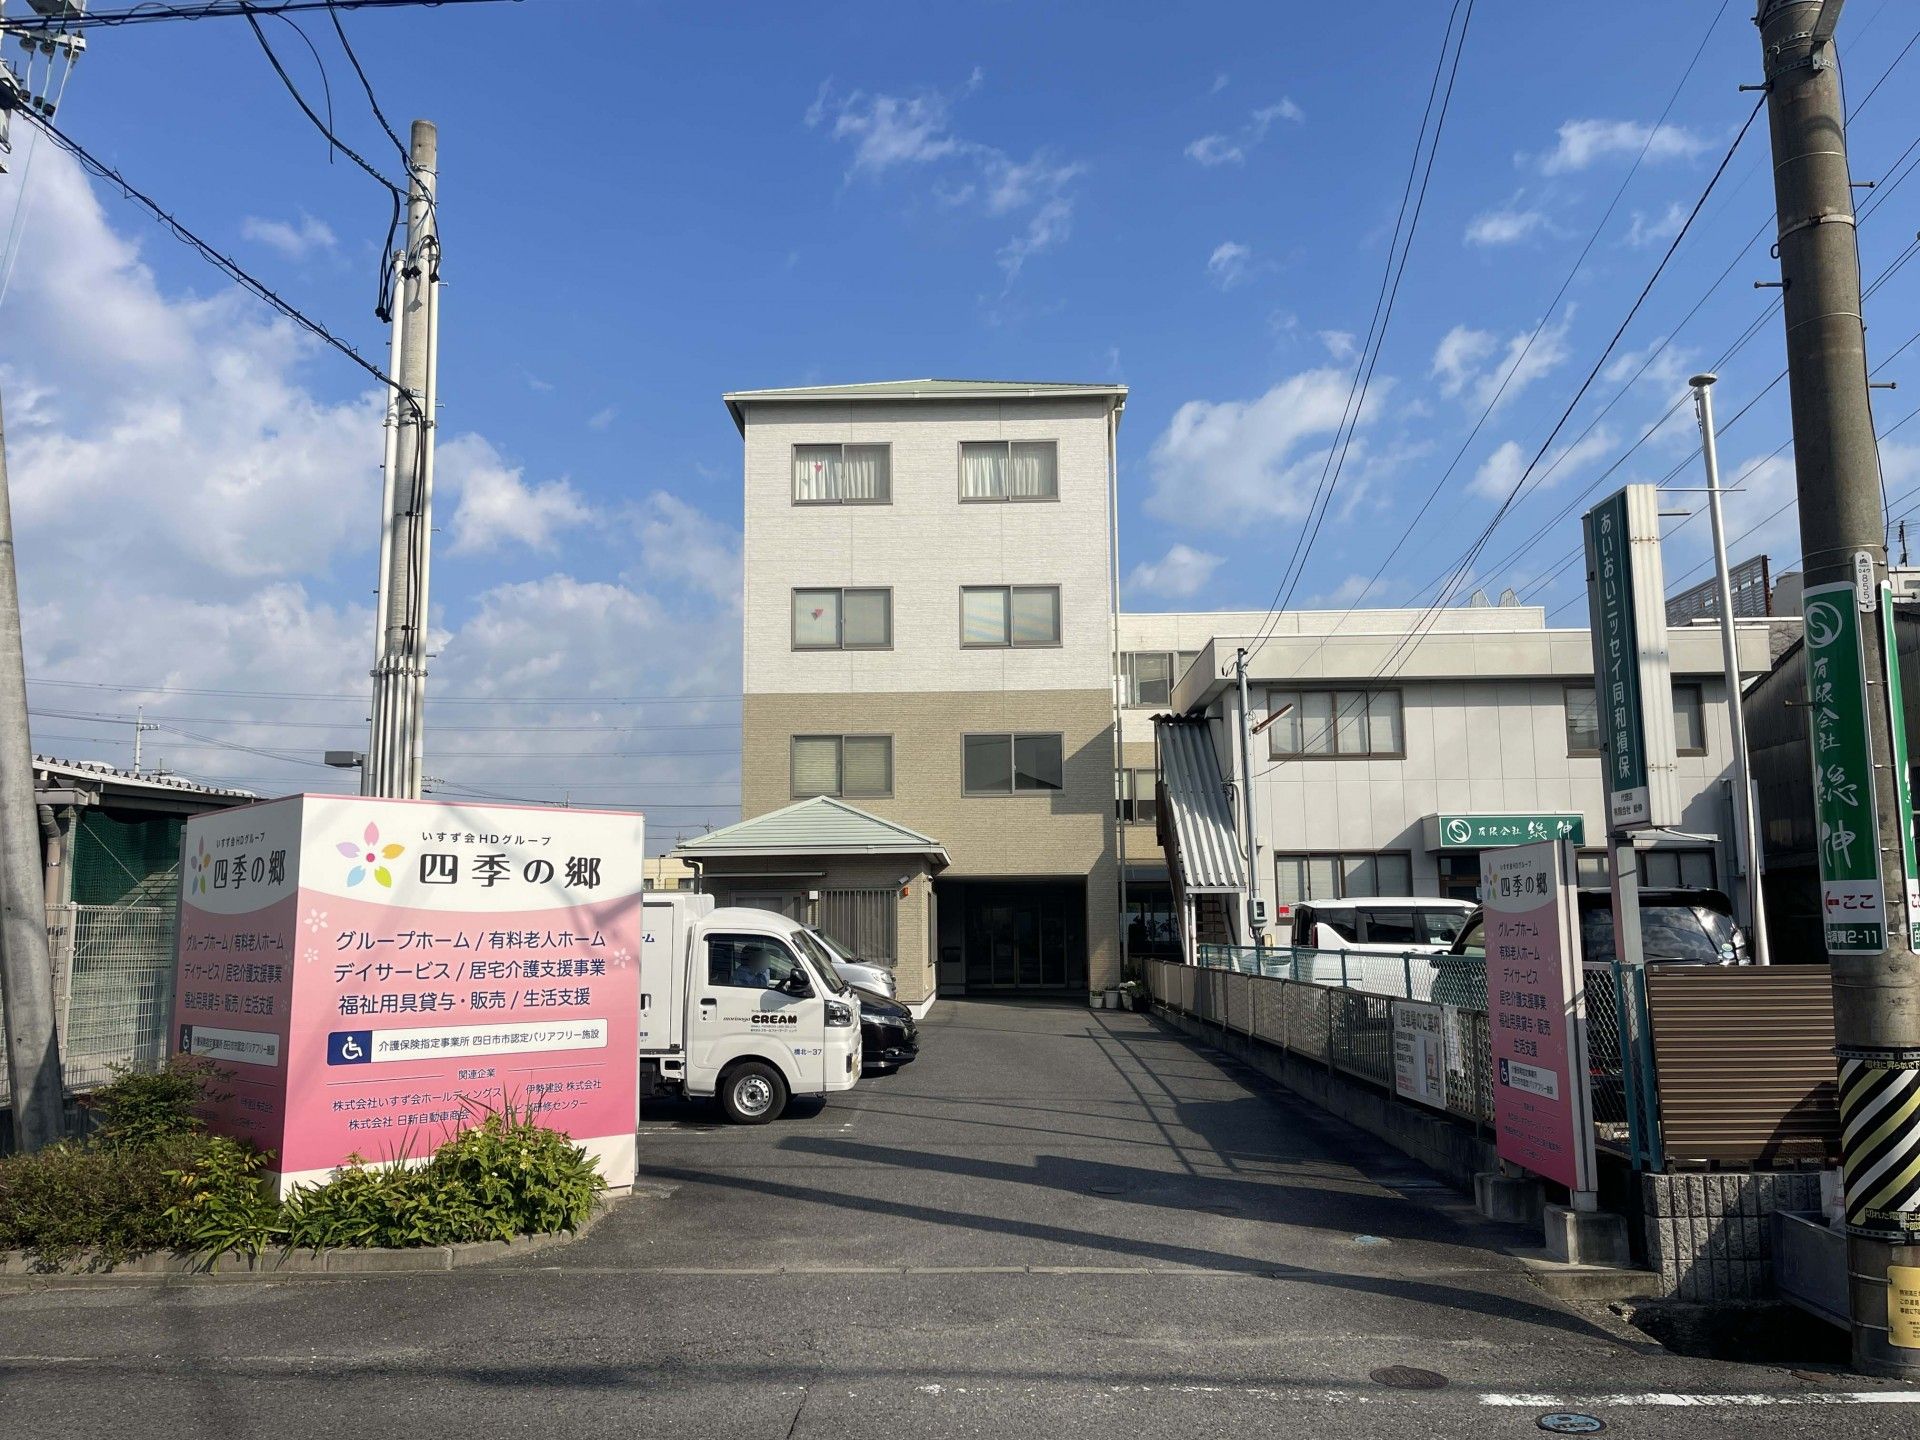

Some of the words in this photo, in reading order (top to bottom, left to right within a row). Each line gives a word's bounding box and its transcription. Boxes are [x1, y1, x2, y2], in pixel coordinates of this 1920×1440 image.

[1861, 574, 1870, 600] 855
[1600, 513, 1631, 780] あいおいニッセイ同和損保
[1813, 656, 1841, 753] 有限会社
[422, 831, 552, 846] いすず会HDグループ
[1478, 826, 1522, 836] 有限会社
[213, 850, 286, 889] 四季の郷
[420, 853, 602, 889] 四季の郷
[1500, 871, 1548, 898] 四季の郷
[1843, 894, 1875, 910] ここ
[1499, 921, 1539, 938] グループホーム
[1499, 945, 1541, 961] 有料老人ホーム
[1503, 968, 1539, 985] デイサービス
[751, 1014, 798, 1024] CREAM
[378, 1034, 469, 1052] 介護保険指定事業所
[472, 1029, 600, 1047] 四日市市認定バリアフリー施設
[1514, 1039, 1539, 1058] 生活支援
[458, 1068, 496, 1080] 関連企業
[566, 1079, 602, 1091] 株式会社
[348, 1115, 393, 1131] 株式会社
